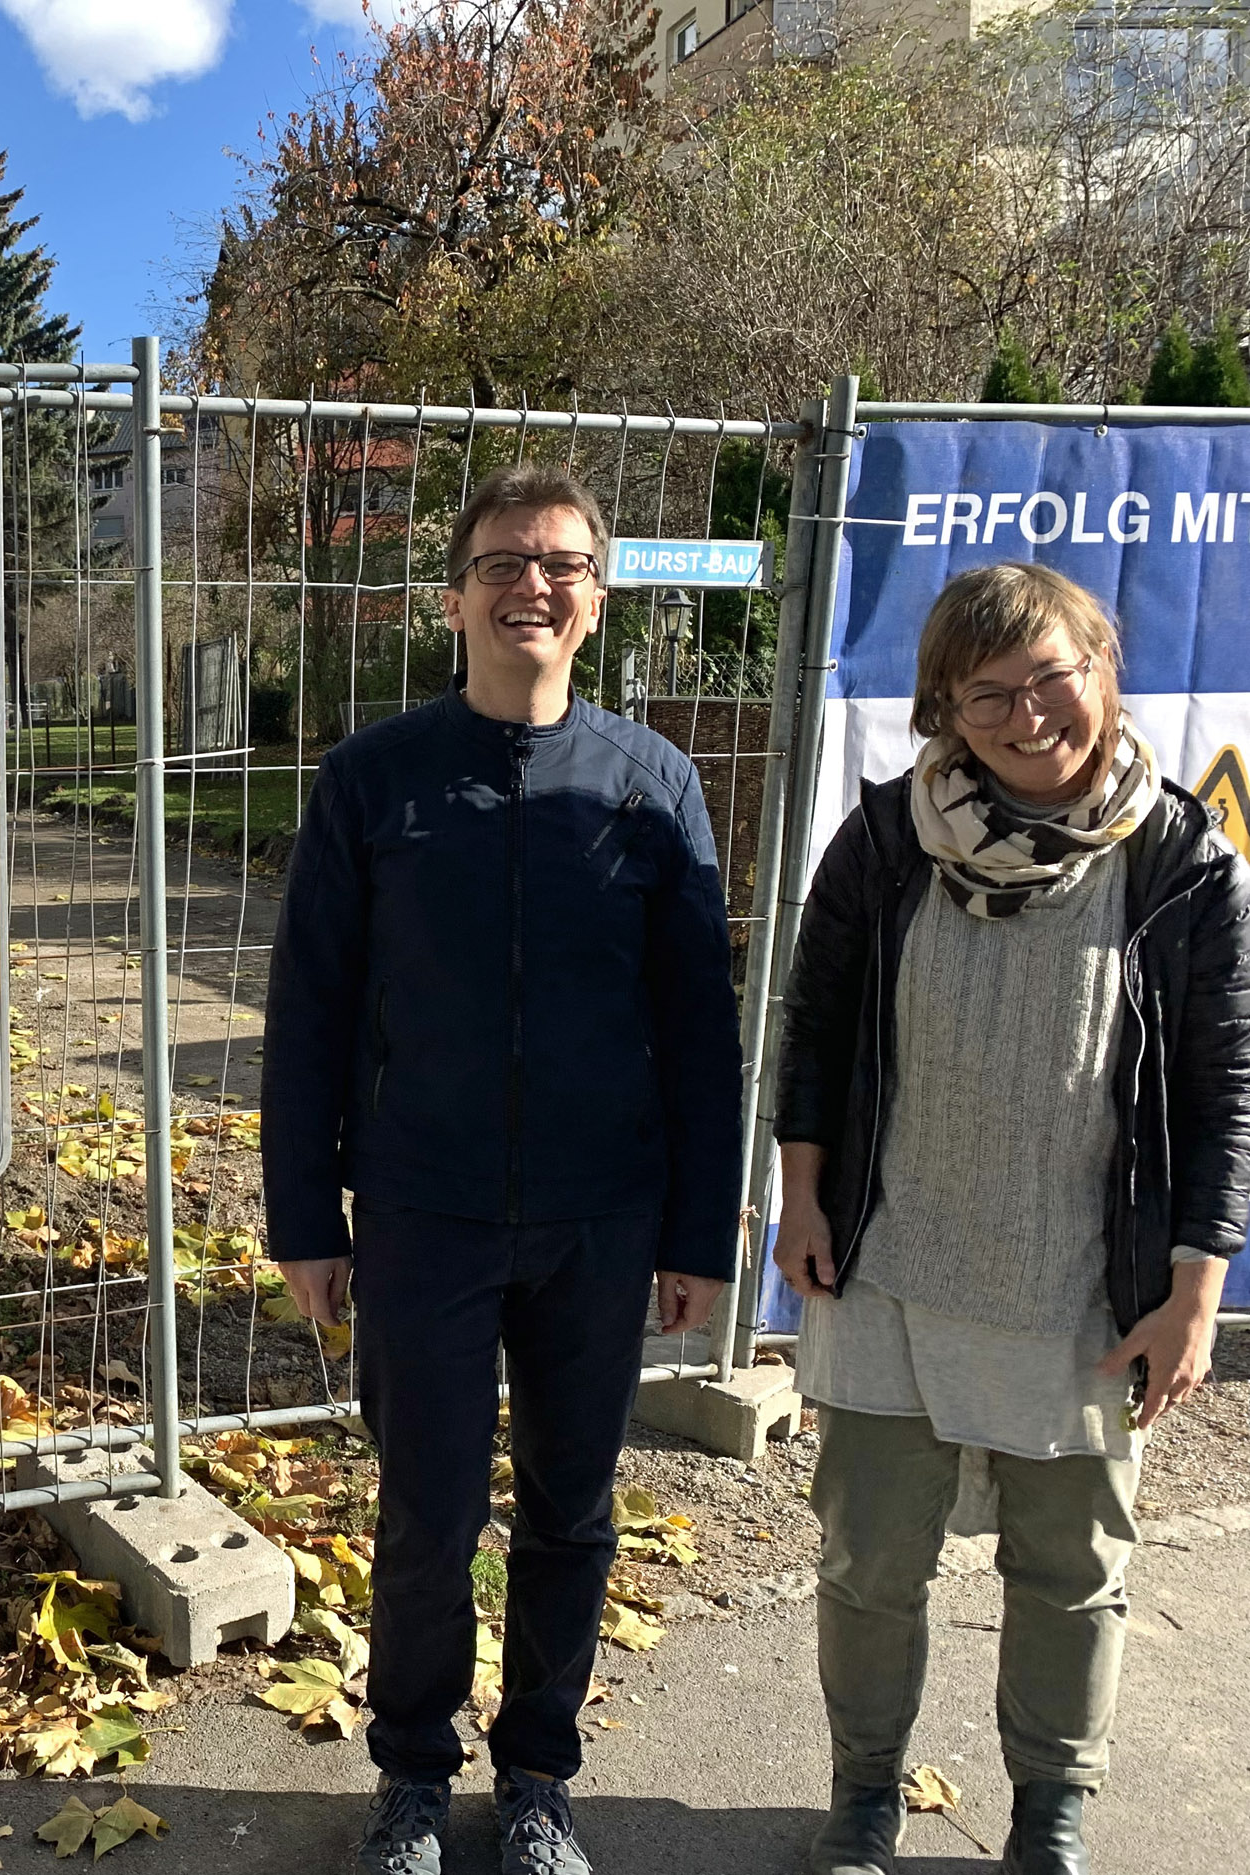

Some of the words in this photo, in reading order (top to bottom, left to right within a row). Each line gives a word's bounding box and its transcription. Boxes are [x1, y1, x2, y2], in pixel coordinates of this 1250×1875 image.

[902, 491, 1150, 546] ERFOLG
[1170, 491, 1250, 543] MI
[625, 549, 752, 575] DURST-BAU
